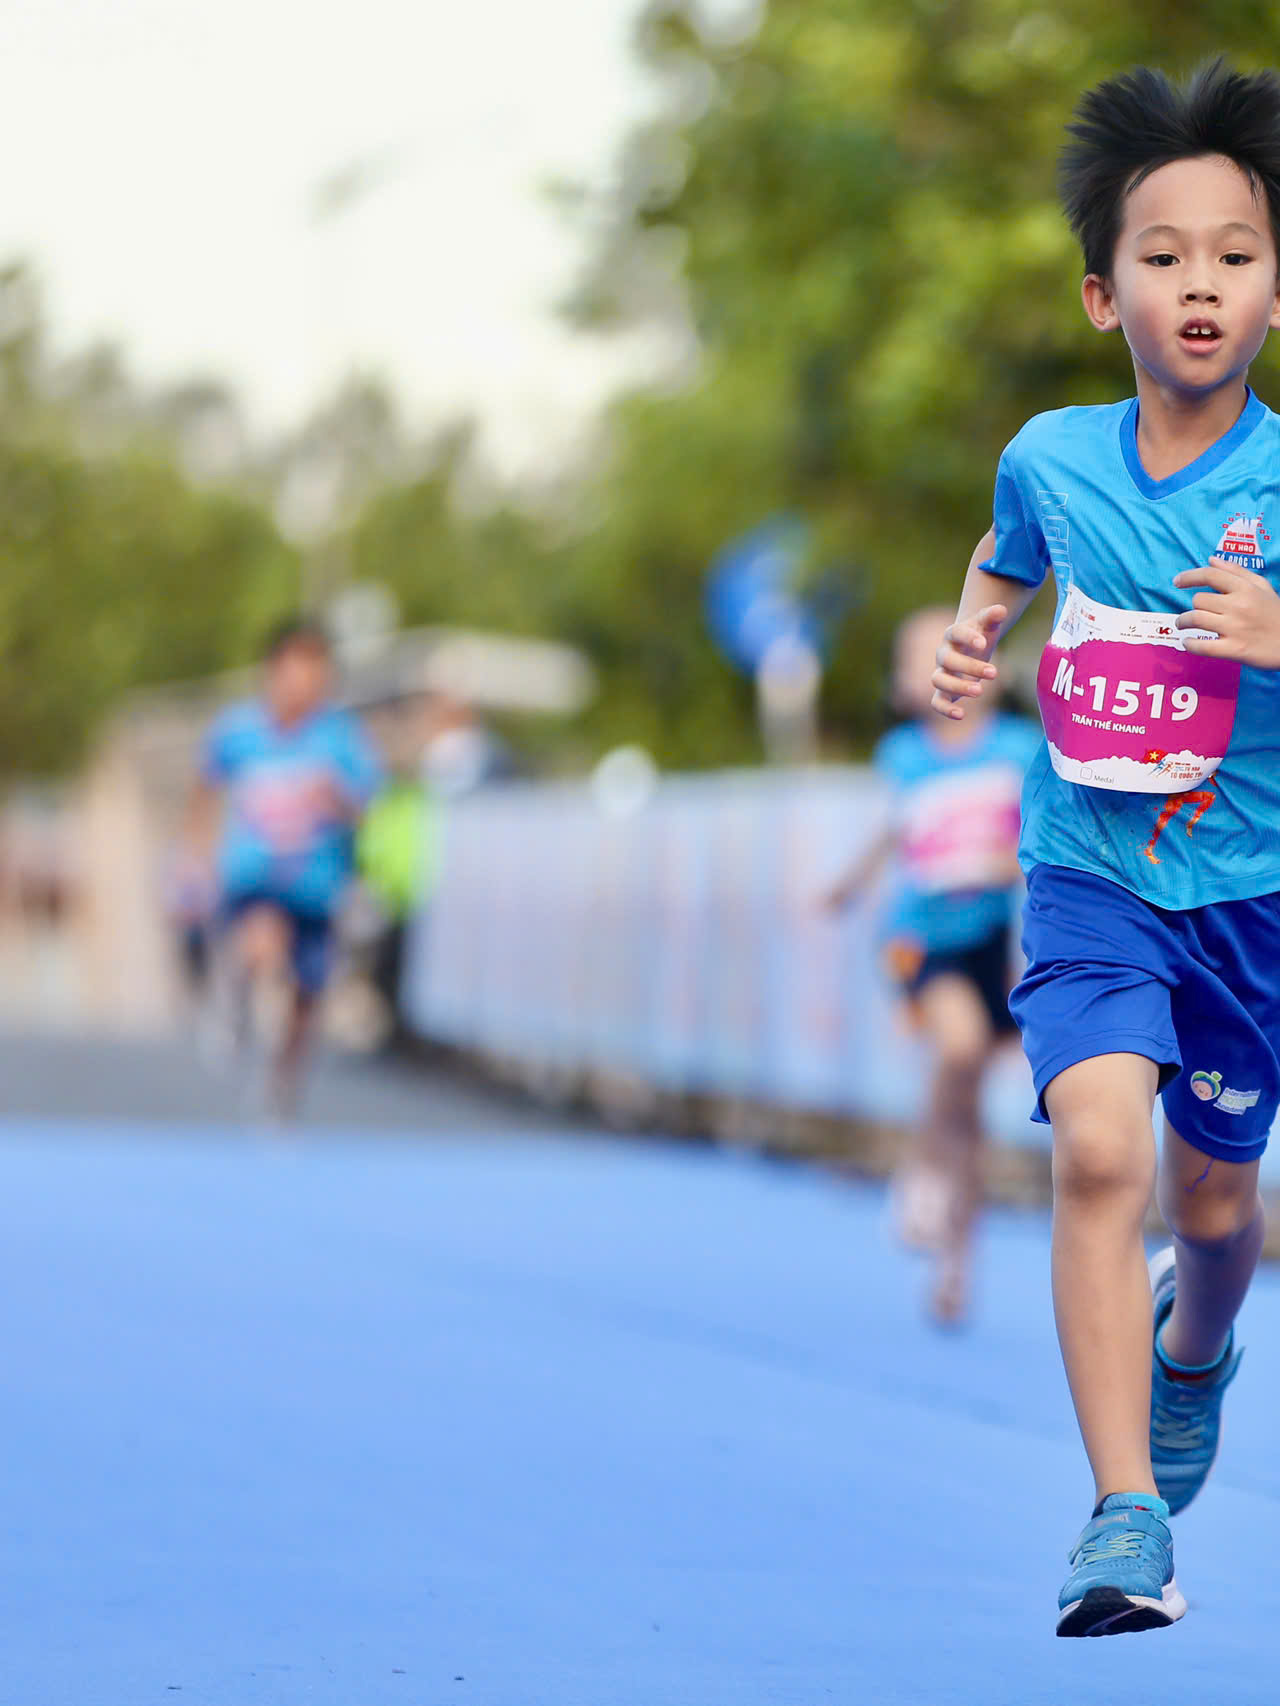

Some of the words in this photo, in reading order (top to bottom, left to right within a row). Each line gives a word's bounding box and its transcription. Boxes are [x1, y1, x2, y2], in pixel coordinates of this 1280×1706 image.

[1051, 657, 1199, 722] M-1519
[1112, 723, 1146, 735] KHANG
[1094, 775, 1115, 784] Medal
